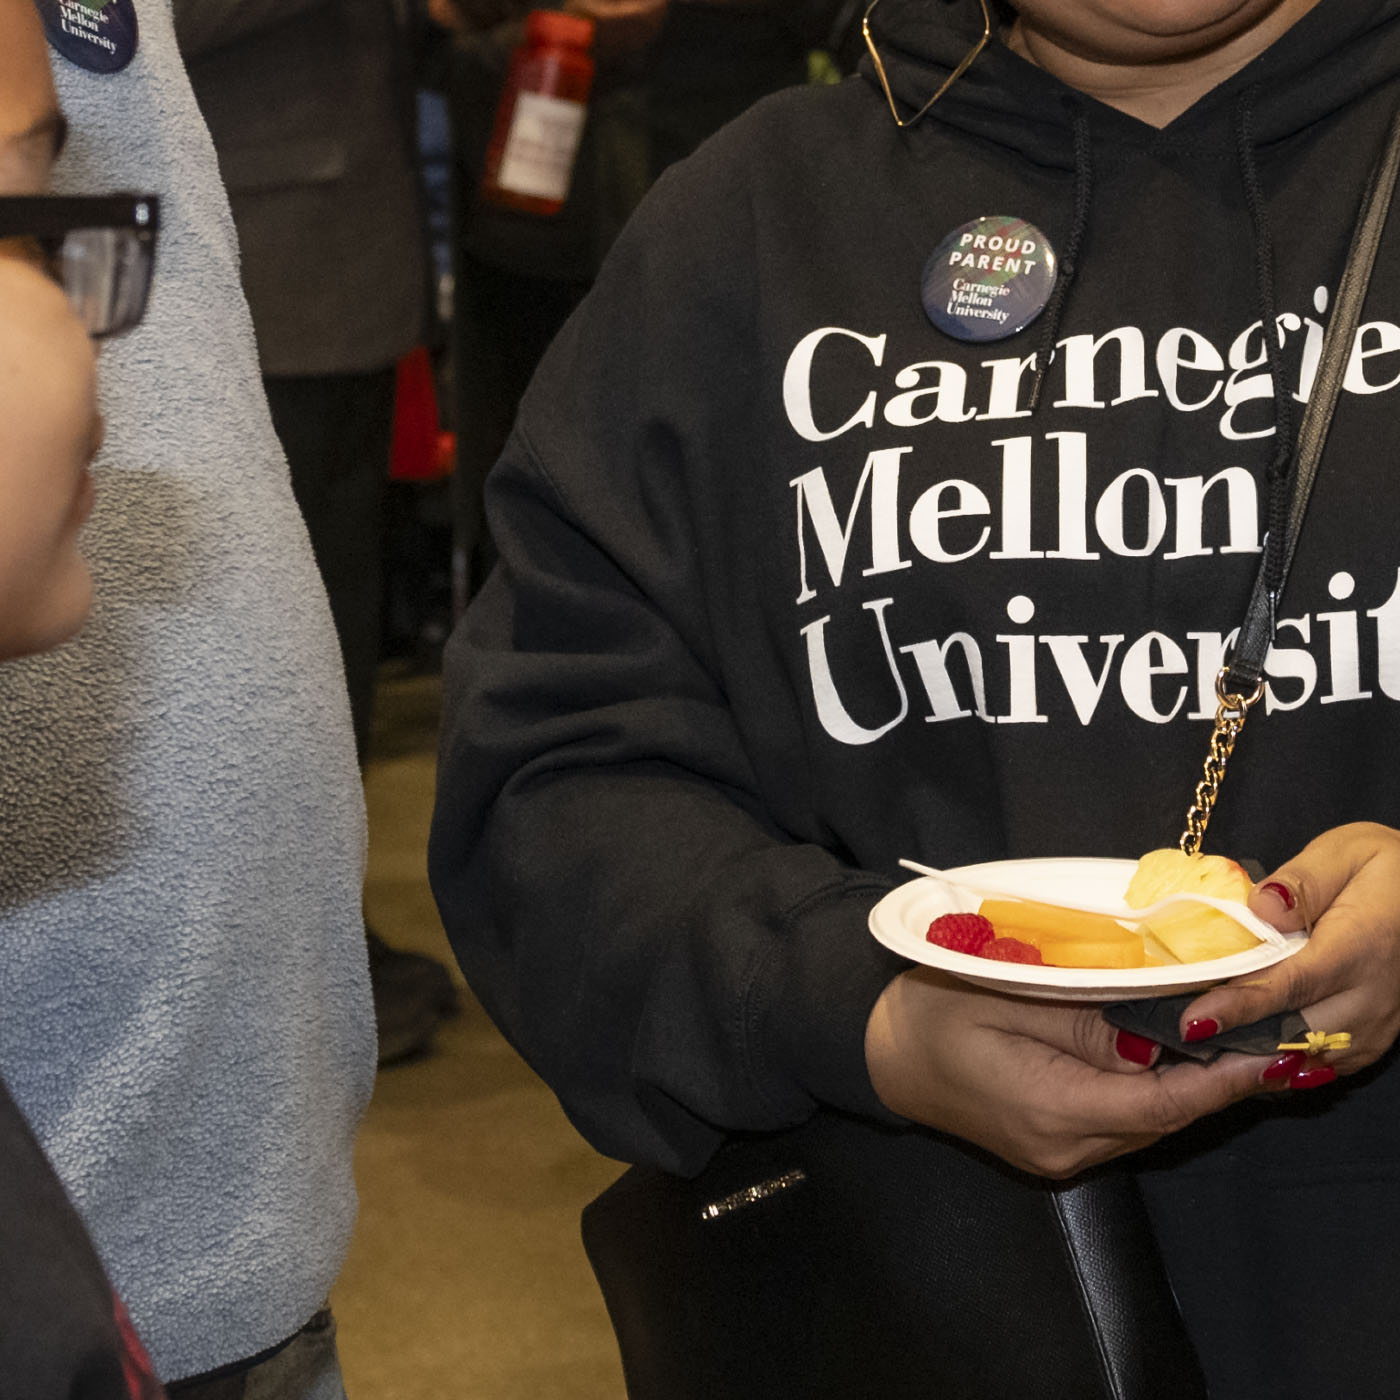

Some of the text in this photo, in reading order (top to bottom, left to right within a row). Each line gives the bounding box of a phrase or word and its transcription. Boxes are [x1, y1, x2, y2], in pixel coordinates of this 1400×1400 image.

[60, 6, 99, 32] Mellon
[61, 19, 117, 55] University
[959, 233, 1036, 254] PROUD
[949, 252, 1036, 275] PARENT
[950, 290, 993, 307] Mellon
[952, 278, 1011, 297] Carnegie
[946, 302, 1010, 324] University
[789, 431, 1271, 604] Mellon
